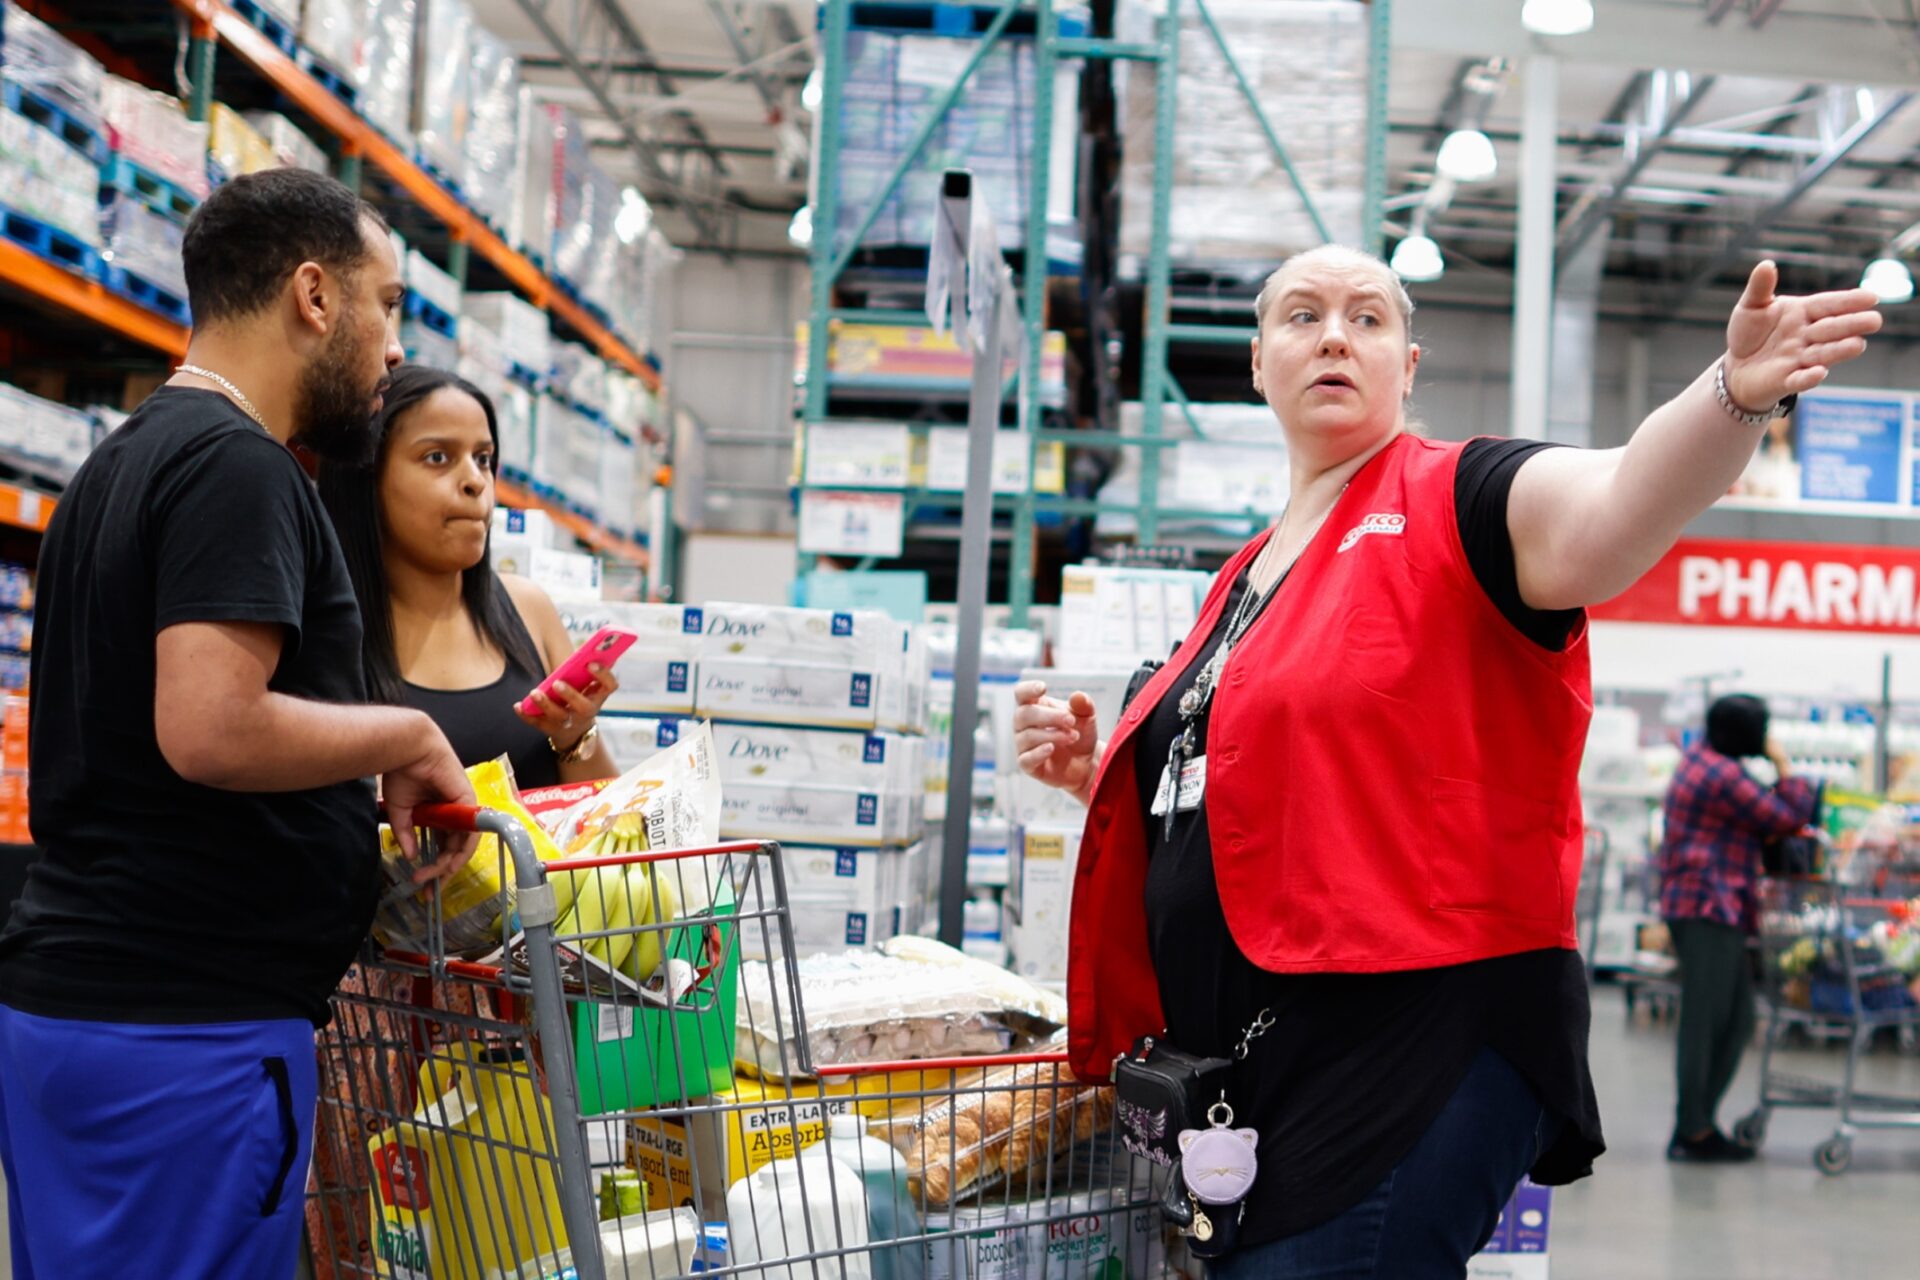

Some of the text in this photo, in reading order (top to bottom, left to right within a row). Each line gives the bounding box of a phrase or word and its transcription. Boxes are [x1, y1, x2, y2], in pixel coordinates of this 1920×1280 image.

[1678, 554, 1920, 627] PHARM
[706, 615, 766, 637] Dove
[705, 675, 745, 690] Dove
[854, 678, 868, 691] 16
[729, 733, 789, 760] Dove
[721, 799, 750, 810] ove
[750, 1101, 846, 1128] EXTR-LAGE
[625, 1123, 683, 1158] ETRA-LRGE
[751, 1123, 832, 1152] Absrb
[626, 1145, 690, 1187] Asorent
